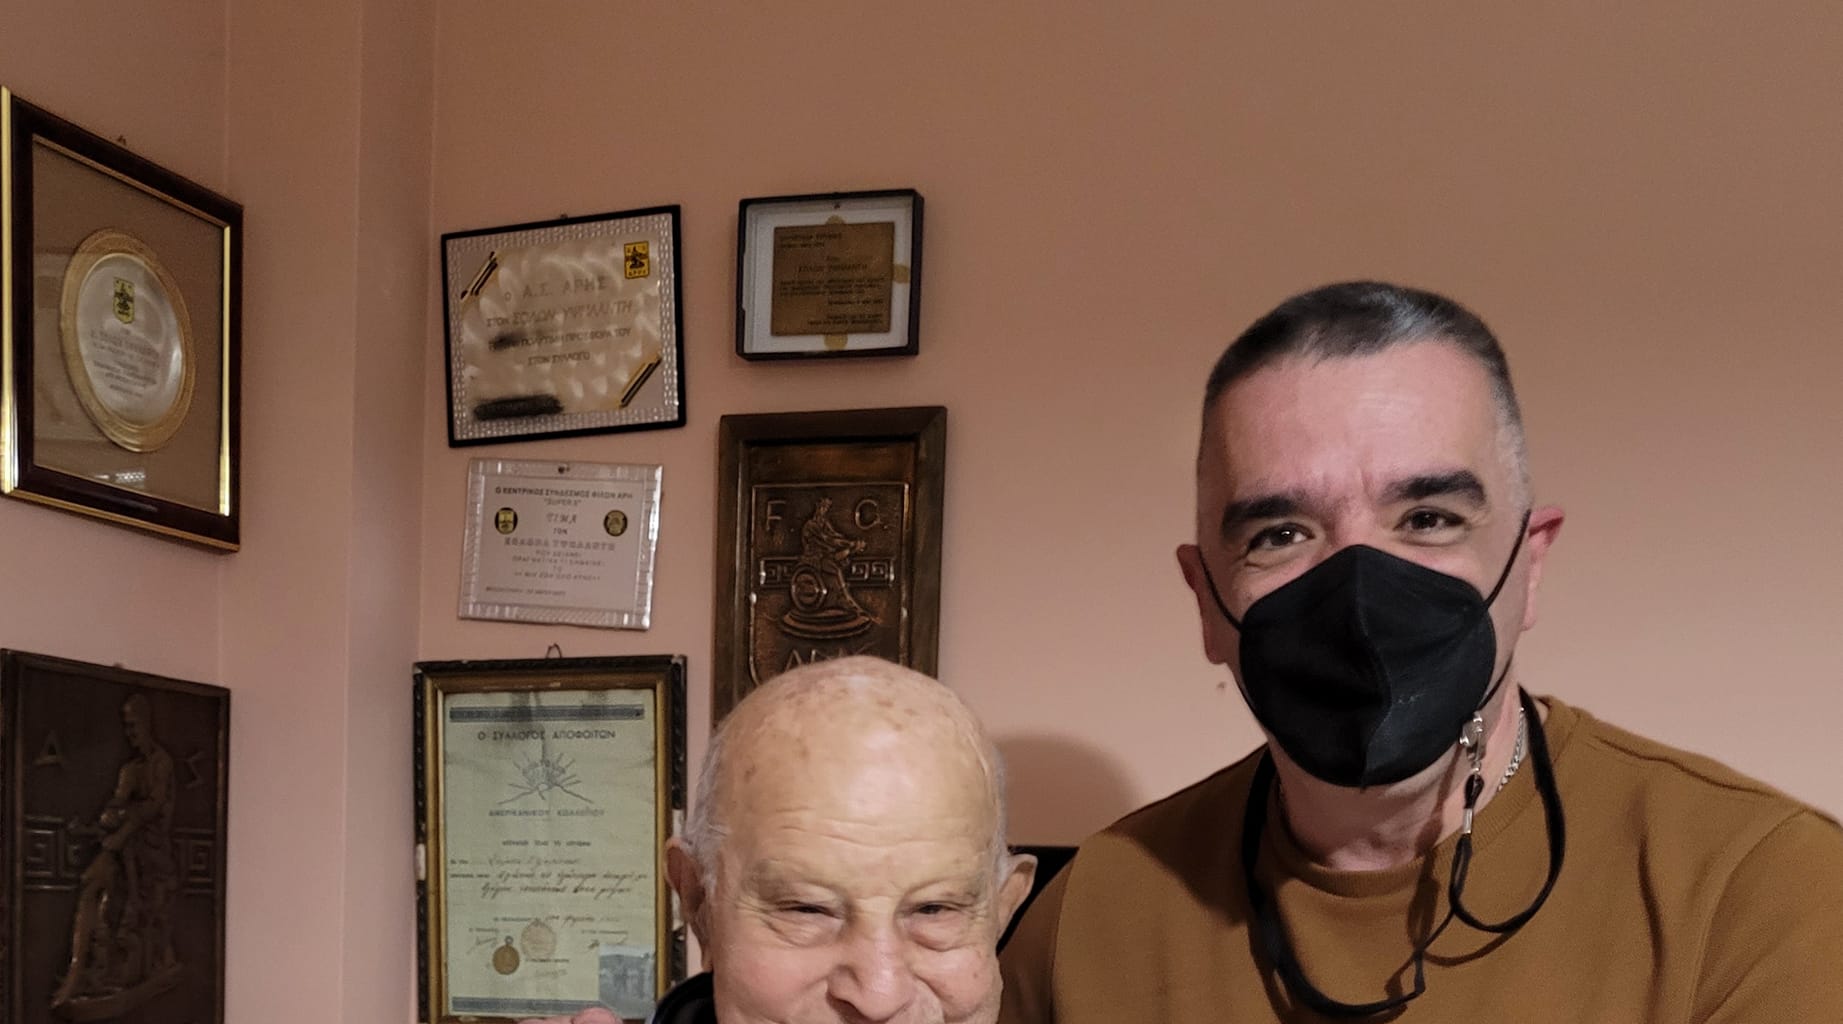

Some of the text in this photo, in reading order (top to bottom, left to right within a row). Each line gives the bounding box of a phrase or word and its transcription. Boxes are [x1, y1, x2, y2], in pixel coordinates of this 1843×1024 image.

[563, 275, 607, 295] ΑΡΗΣ
[503, 487, 544, 496] ΚΕΝΤΡΙΚΟΣ
[492, 730, 546, 741] ΣΥΛΛΟΓΟΣ
[552, 729, 616, 740] ΑΠΟΦΟΙΤΩΝ
